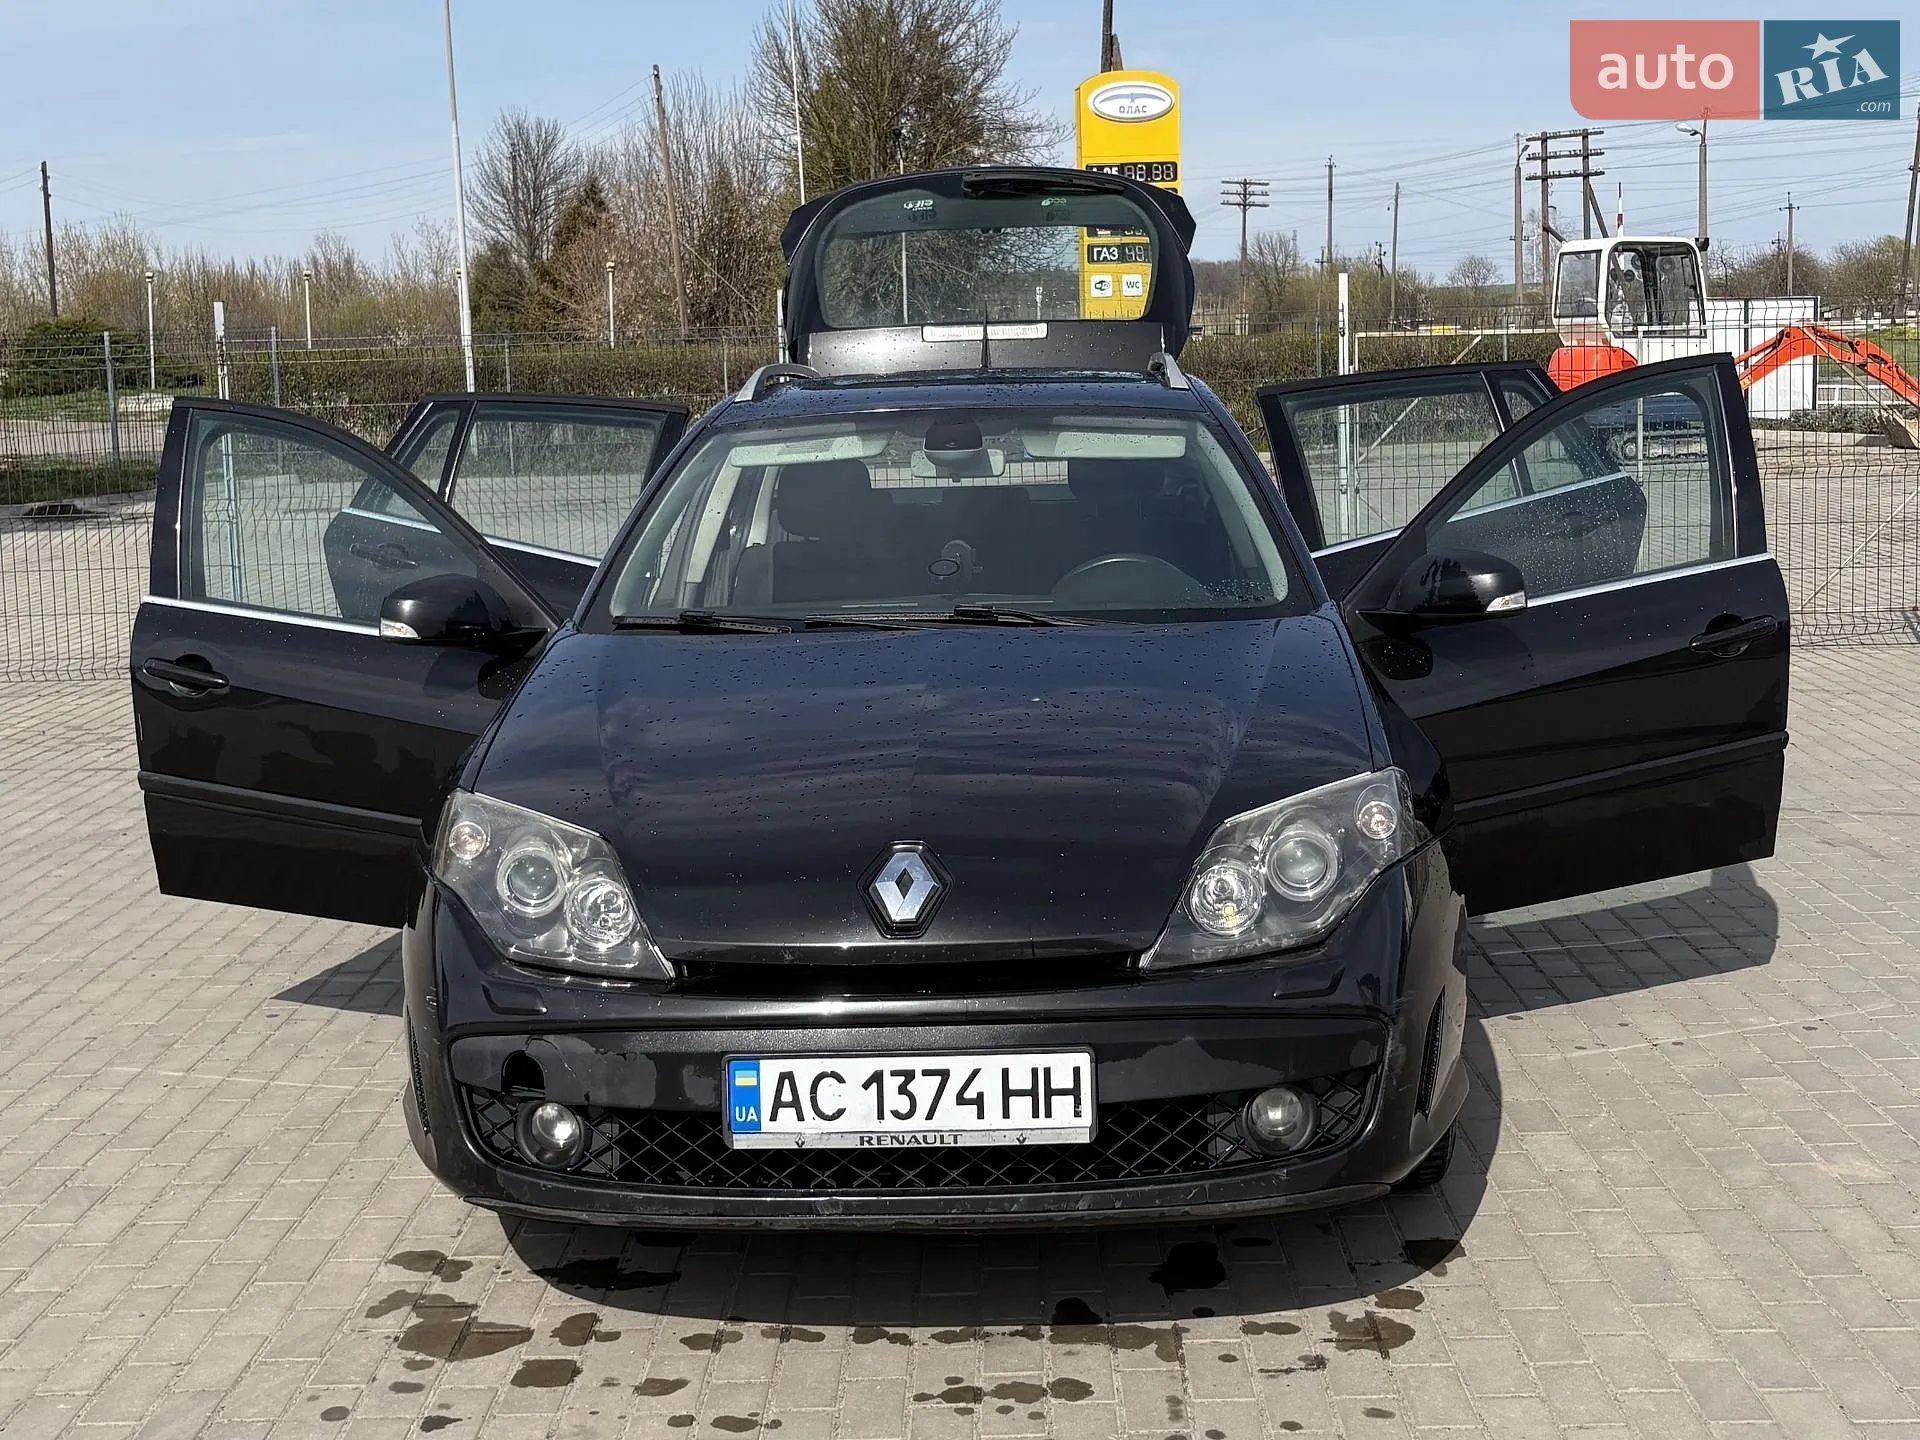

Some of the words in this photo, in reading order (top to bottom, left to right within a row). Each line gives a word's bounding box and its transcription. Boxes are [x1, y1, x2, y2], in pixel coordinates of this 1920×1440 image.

[1093, 247, 1119, 261] ГАЗ
[1126, 281, 1140, 289] WC
[769, 1070, 847, 1122] AC
[861, 1068, 985, 1121] 1374
[1001, 1066, 1082, 1119] HH
[735, 1107, 758, 1122] UA
[858, 1133, 963, 1147] RENAULT
